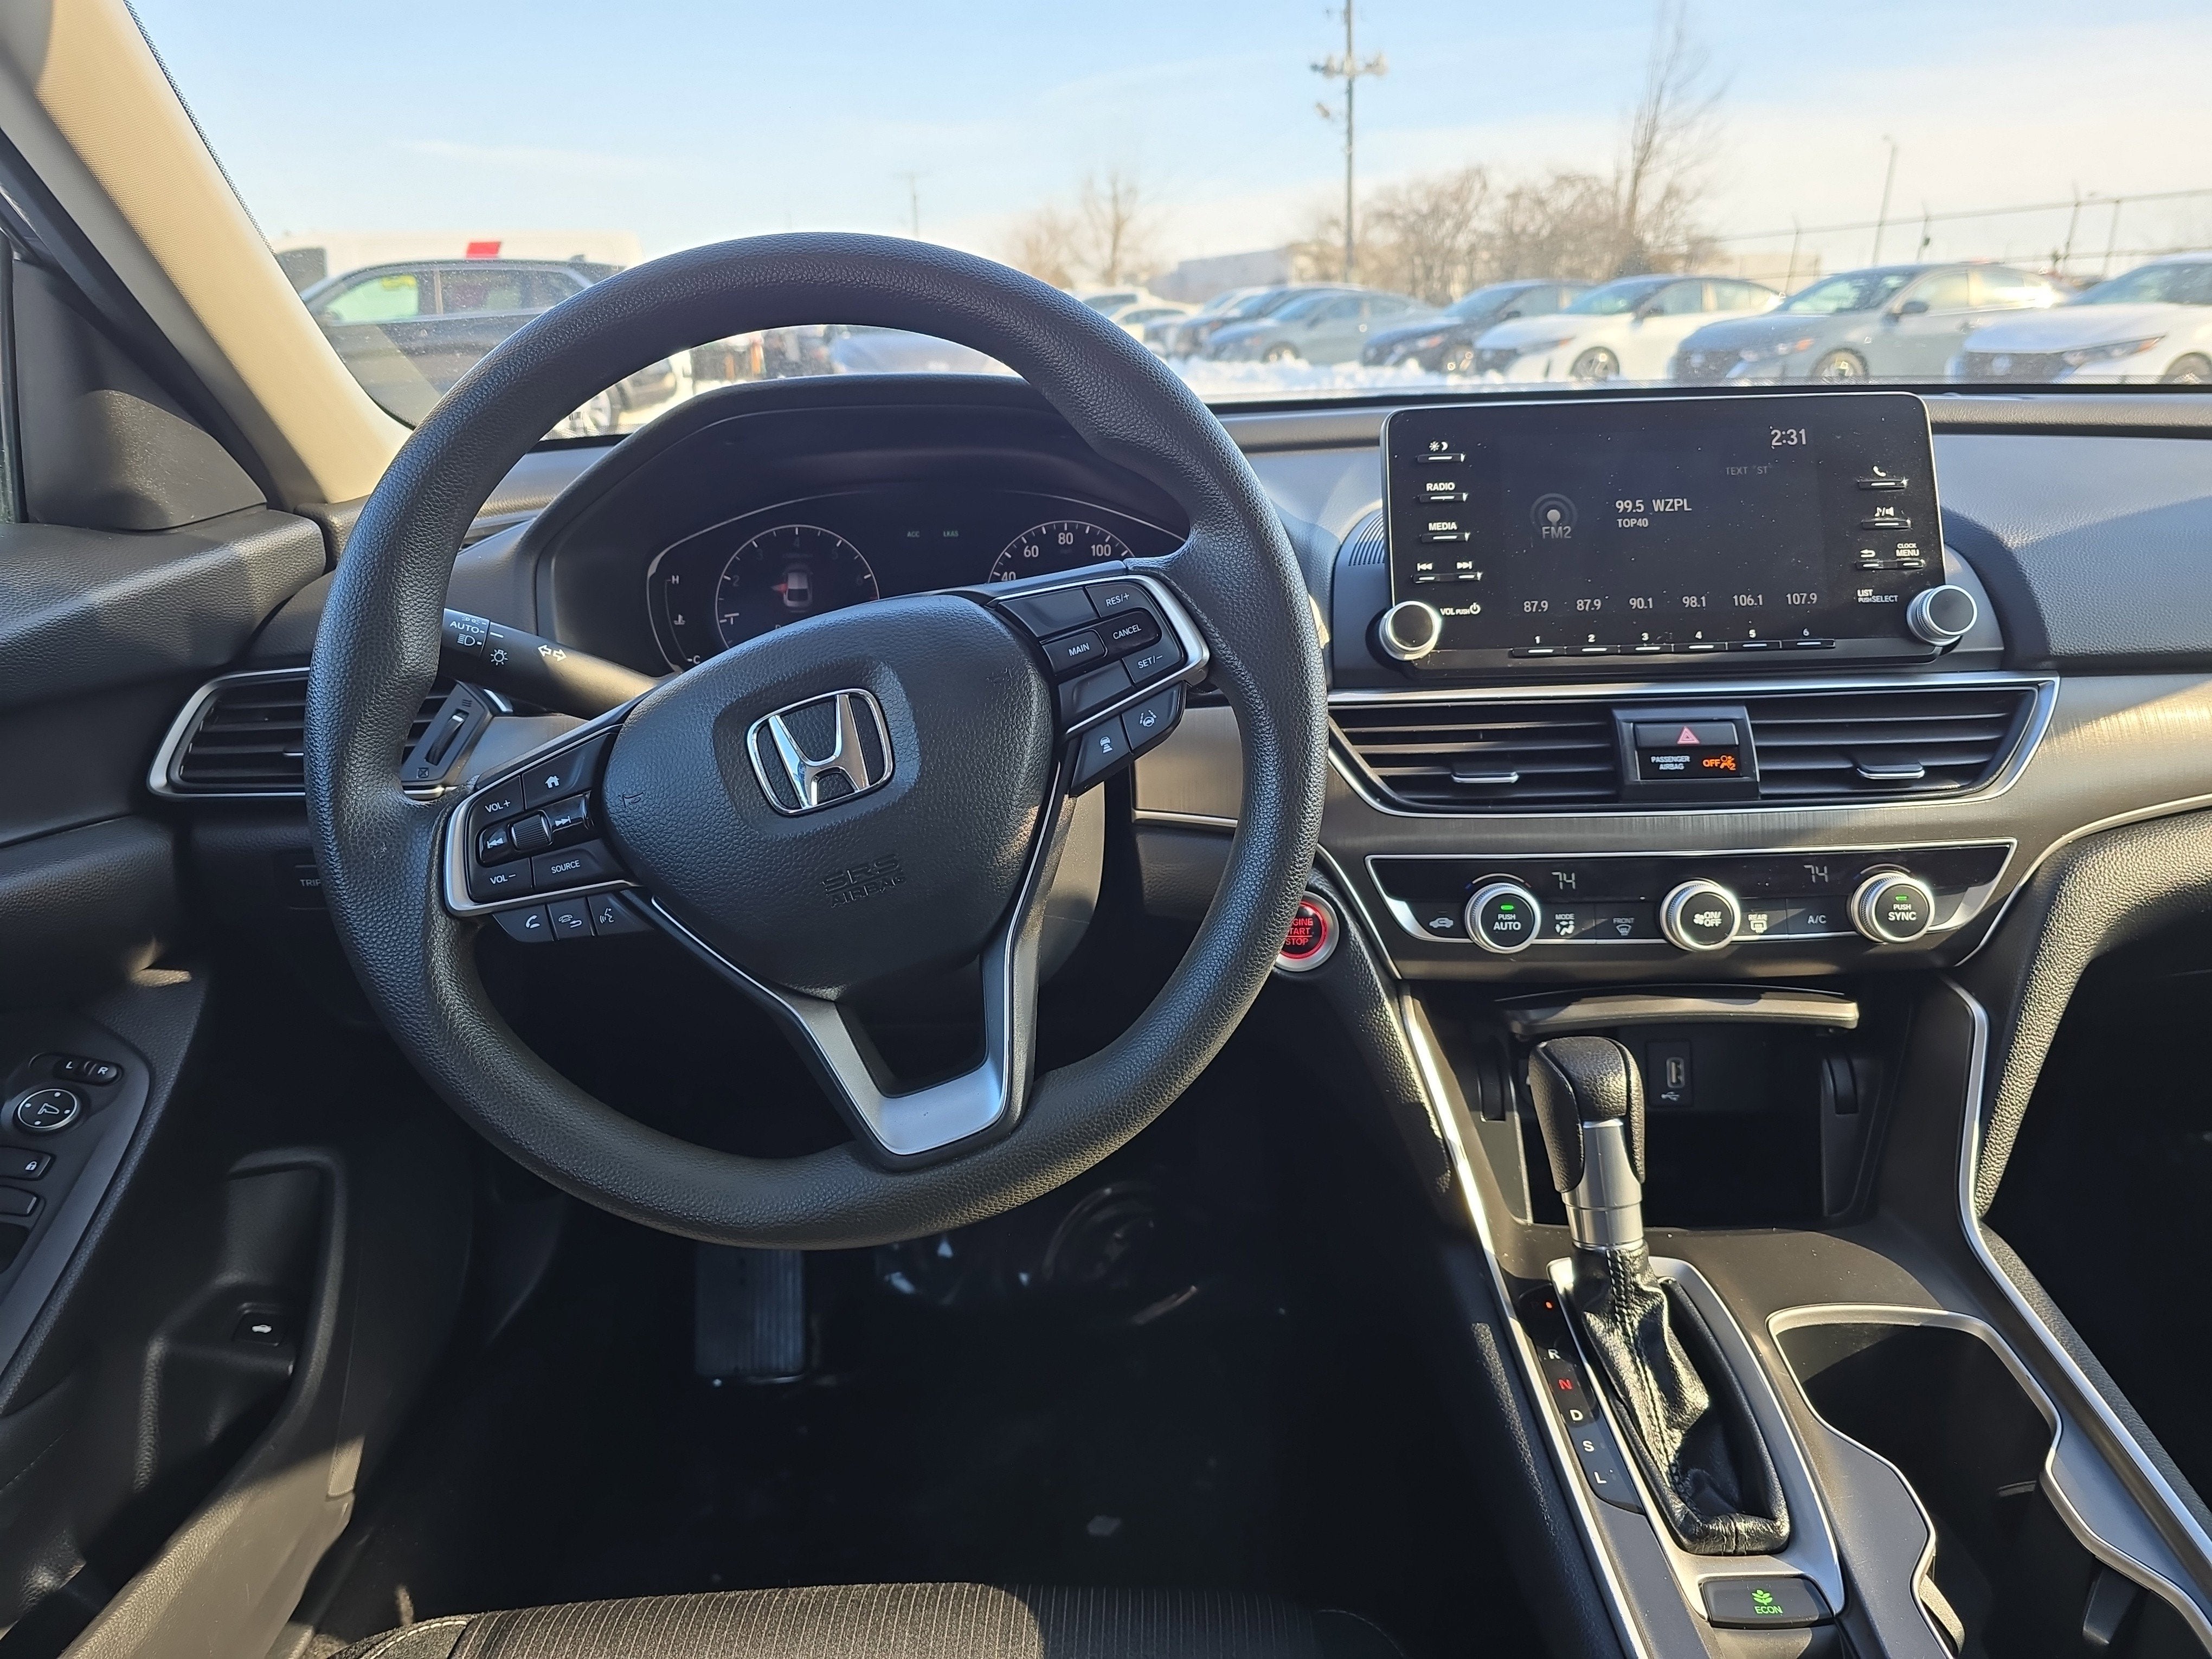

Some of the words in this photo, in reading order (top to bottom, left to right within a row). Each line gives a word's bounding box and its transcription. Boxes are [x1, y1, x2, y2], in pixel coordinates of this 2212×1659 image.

[1770, 428, 1806, 446] 2:31
[1426, 481, 1455, 491] RADIO
[1615, 499, 1644, 513] 99.5
[1652, 498, 1692, 512] WZPL
[1429, 522, 1457, 531] MEDIA
[1617, 518, 1649, 528] TOP40
[1058, 532, 1073, 545] 80
[1542, 527, 1571, 539] FM2
[1024, 545, 1039, 558] 60
[1091, 544, 1111, 557] 100
[672, 575, 679, 584] H
[1001, 571, 1017, 581] 40
[1105, 592, 1130, 607] RES/+
[1523, 600, 1548, 613] 87.9
[1576, 599, 1602, 611] 87.9
[1629, 597, 1653, 609] 90.1
[1682, 595, 1706, 608] 98.1
[1733, 594, 1763, 607] 106.1
[1786, 593, 1817, 605] 107.9
[449, 621, 480, 634] AUTO
[1113, 624, 1142, 640] CANCEL
[1535, 635, 1540, 644] 1
[1588, 634, 1596, 642] 2
[1641, 633, 1649, 641] 3
[1695, 631, 1702, 639] 4
[1748, 629, 1756, 638] 5
[1803, 628, 1810, 636] 6
[1068, 642, 1090, 657] MAIN
[693, 655, 700, 665] C
[1137, 655, 1163, 668] SET/-
[1702, 758, 1720, 768] OFF
[485, 800, 511, 813] VOL+
[551, 859, 581, 874] SOURCE
[1803, 865, 1829, 883] 74
[1552, 872, 1576, 890] 74
[1704, 911, 1721, 919] ON/
[1808, 915, 1827, 924] A/C
[1888, 911, 1917, 921] SYNC
[1291, 918, 1313, 926] GINE
[1493, 922, 1521, 930] AUTO
[1705, 919, 1721, 927] OFF
[66, 1061, 73, 1069] L
[98, 1066, 108, 1075] R
[1548, 1349, 1560, 1360] R
[1559, 1379, 1573, 1390] N
[1570, 1409, 1583, 1421] D
[1583, 1440, 1595, 1452] S
[1594, 1471, 1607, 1484] L
[1754, 1605, 1783, 1614] ECON
